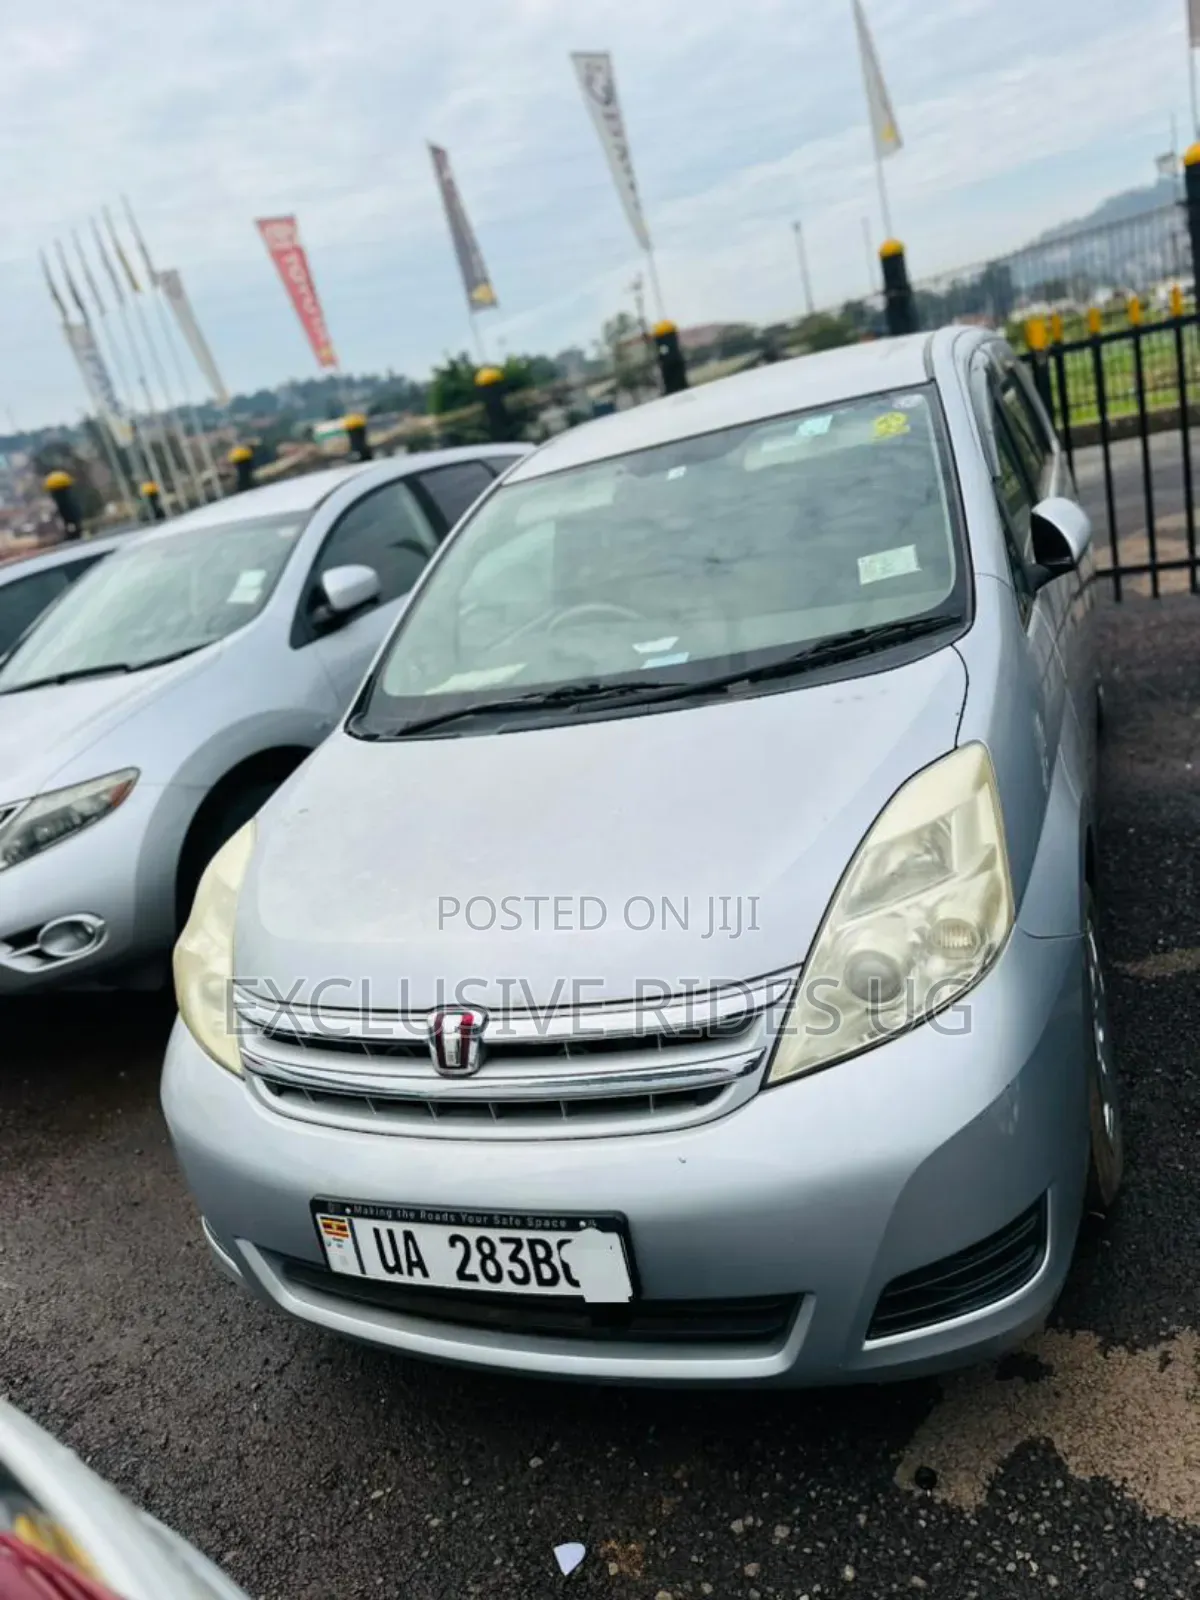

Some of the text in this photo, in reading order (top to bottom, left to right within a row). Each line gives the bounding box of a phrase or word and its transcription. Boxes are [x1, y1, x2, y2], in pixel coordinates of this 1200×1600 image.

[353, 1204, 567, 1230] Making the Roads Your Safe Space
[372, 1227, 430, 1279] UA
